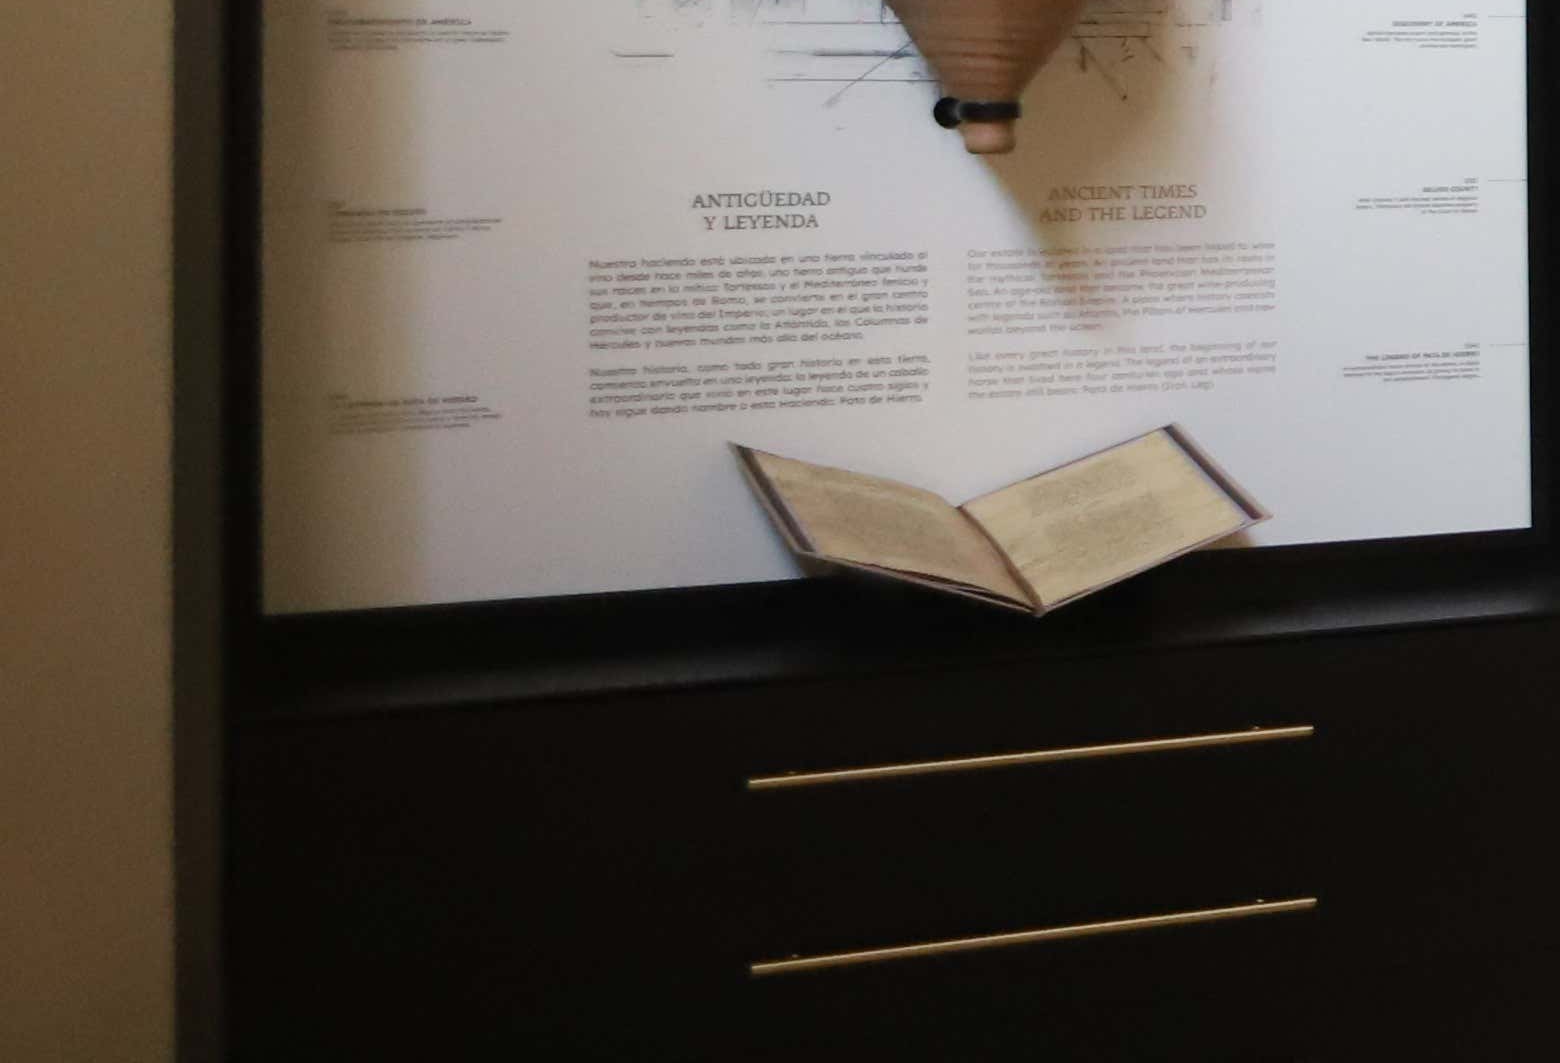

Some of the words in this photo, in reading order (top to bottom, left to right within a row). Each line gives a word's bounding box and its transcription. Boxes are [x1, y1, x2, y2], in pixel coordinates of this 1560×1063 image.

[692, 190, 832, 209] ANTIGÜEDAD
[1048, 185, 1133, 201] ANCIENT
[1140, 184, 1198, 199] TIMES
[1040, 208, 1082, 222] AND
[1087, 206, 1126, 221] THE
[1133, 204, 1207, 221] LEGEND
[704, 216, 716, 231] Y
[724, 214, 819, 230] LEYENDA
